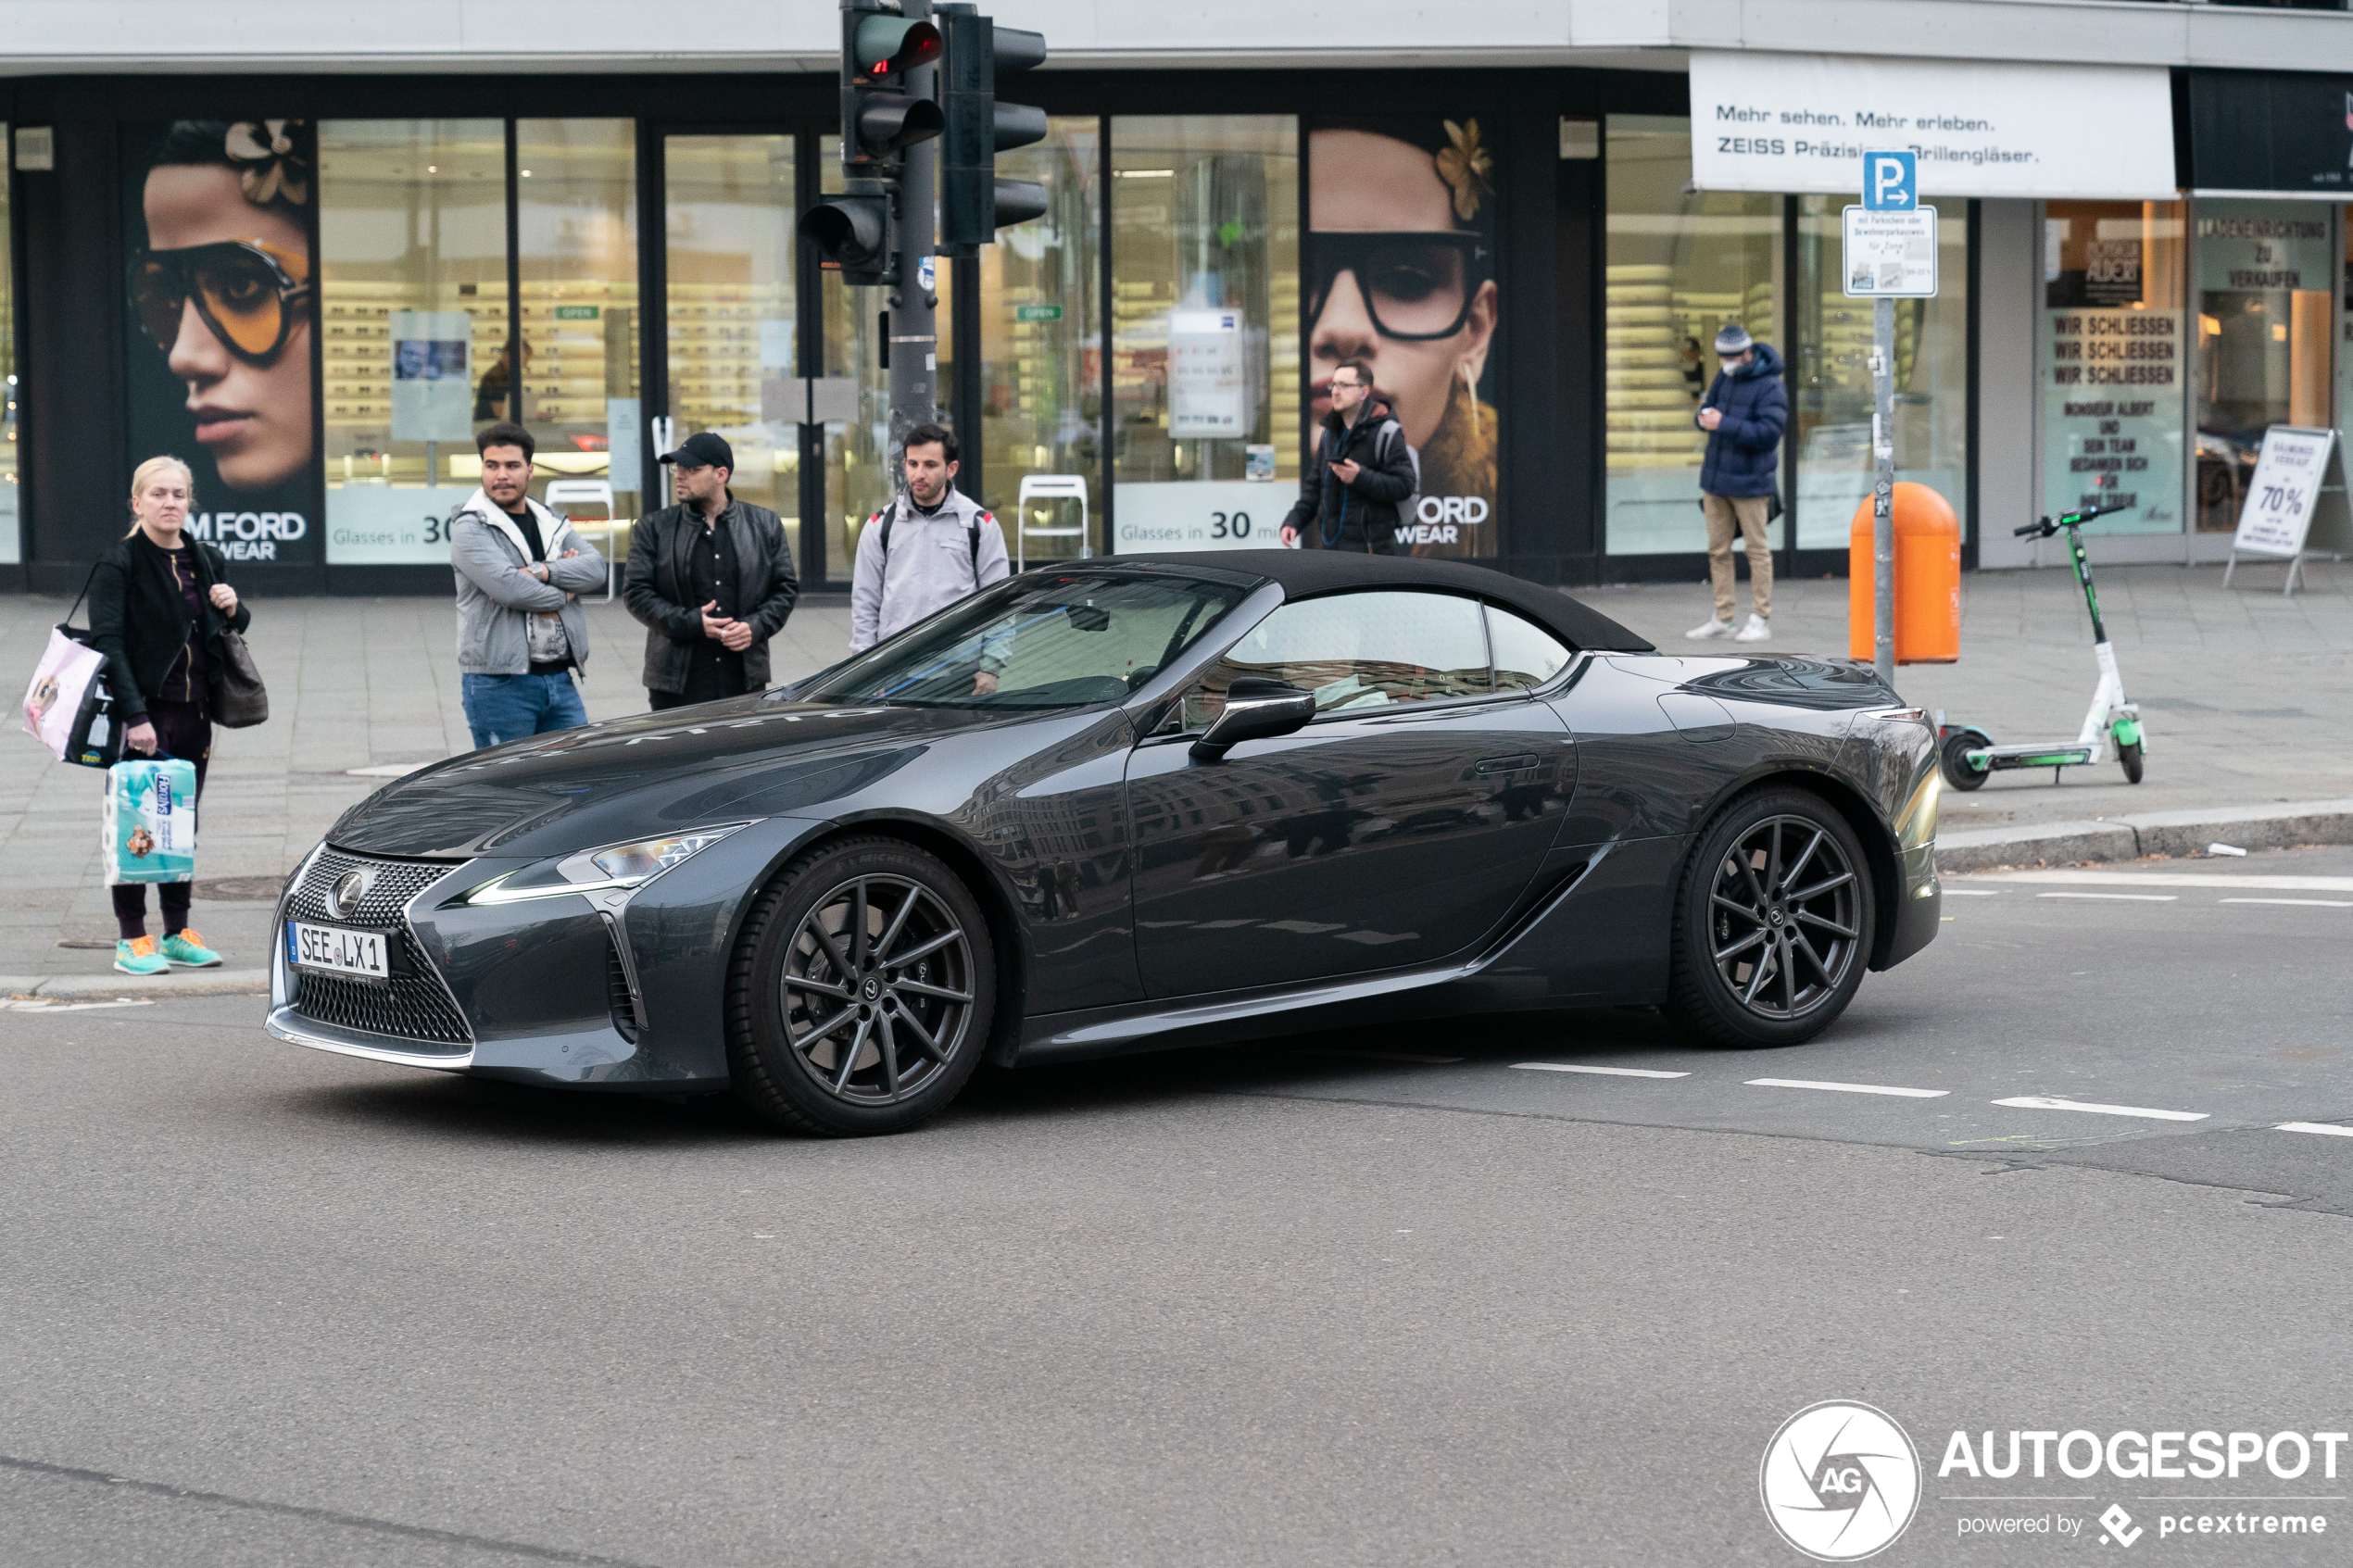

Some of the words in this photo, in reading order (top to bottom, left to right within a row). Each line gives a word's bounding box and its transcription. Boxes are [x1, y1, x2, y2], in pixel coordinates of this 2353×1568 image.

[1717, 105, 1771, 122] Mehr
[1780, 108, 1846, 127] sehen.
[1856, 111, 1907, 129] Mehr
[1916, 114, 1995, 132] erleben.
[1718, 137, 1785, 156] ZEISS
[1875, 157, 1905, 205] P
[1871, 216, 1905, 224] Parkschein
[1855, 227, 1926, 236] Bewohnerparkausweis
[1885, 242, 1903, 250] Zone
[2256, 244, 2271, 264] ZU
[2229, 270, 2300, 288] VERKAUFEN
[2054, 316, 2082, 334] WIR
[2088, 316, 2174, 334] SCHLIESSEN
[2054, 341, 2082, 359] WIR
[2088, 341, 2174, 359] SCHLIESSEN
[2054, 366, 2082, 384] WIR
[2088, 366, 2174, 384] SCHLIESSEN
[2109, 437, 2136, 453] TEAM
[1417, 495, 1489, 525] ORD
[215, 512, 307, 542] FORD
[1120, 523, 1182, 541] Glasses
[1189, 523, 1202, 540] in
[1211, 511, 1251, 539] 30
[333, 527, 395, 546] Glasses
[400, 527, 416, 545] in
[157, 775, 171, 815] Floralys
[301, 927, 333, 964] SEE
